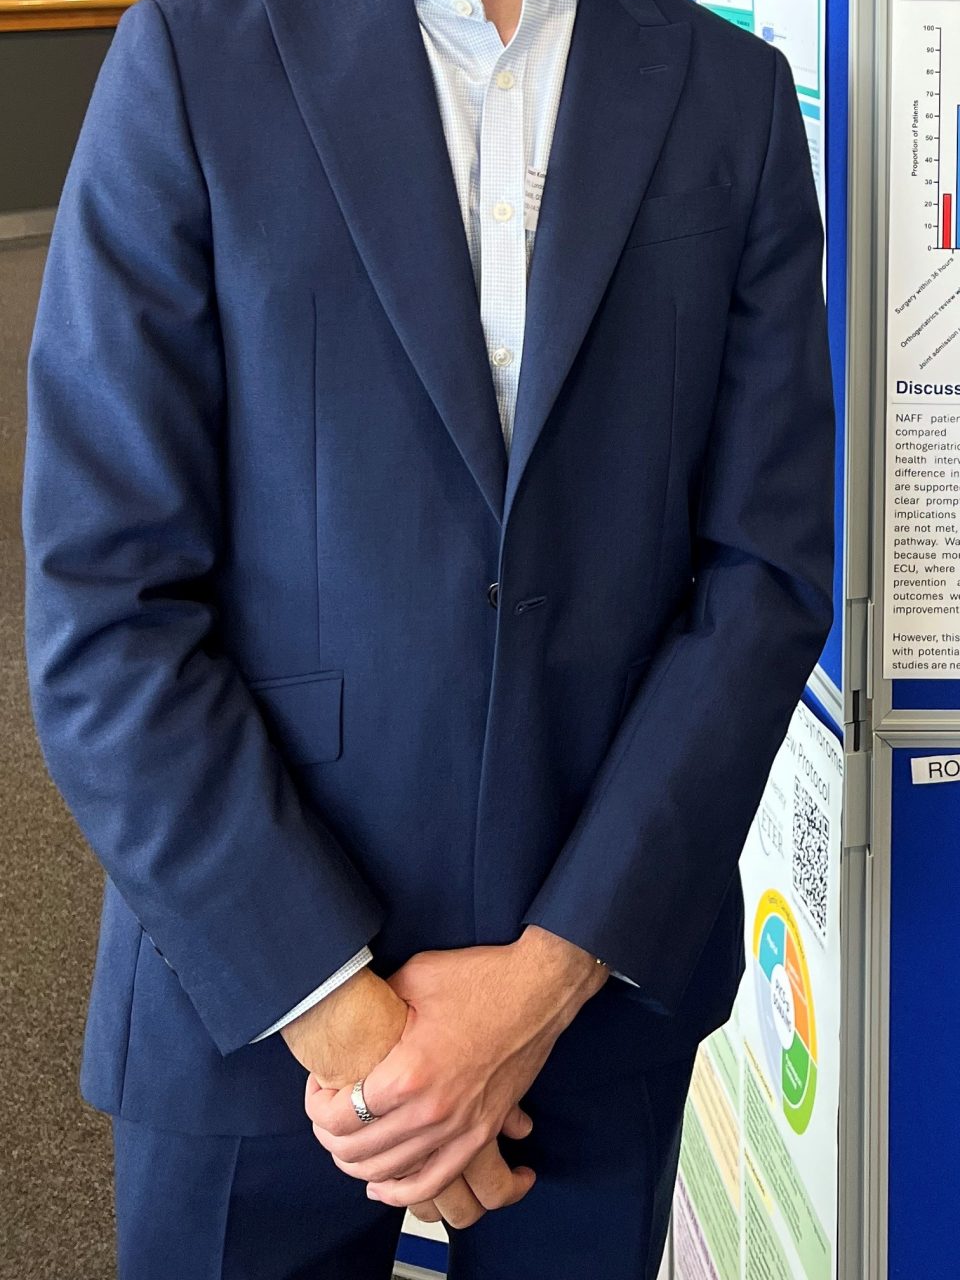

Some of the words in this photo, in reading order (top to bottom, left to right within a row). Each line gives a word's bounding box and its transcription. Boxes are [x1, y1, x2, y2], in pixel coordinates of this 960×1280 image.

[912, 129, 918, 138] of
[911, 140, 919, 177] Proportion
[895, 294, 916, 314] Surgery
[916, 279, 932, 294] within
[931, 271, 939, 279] 36
[938, 257, 954, 272] hours
